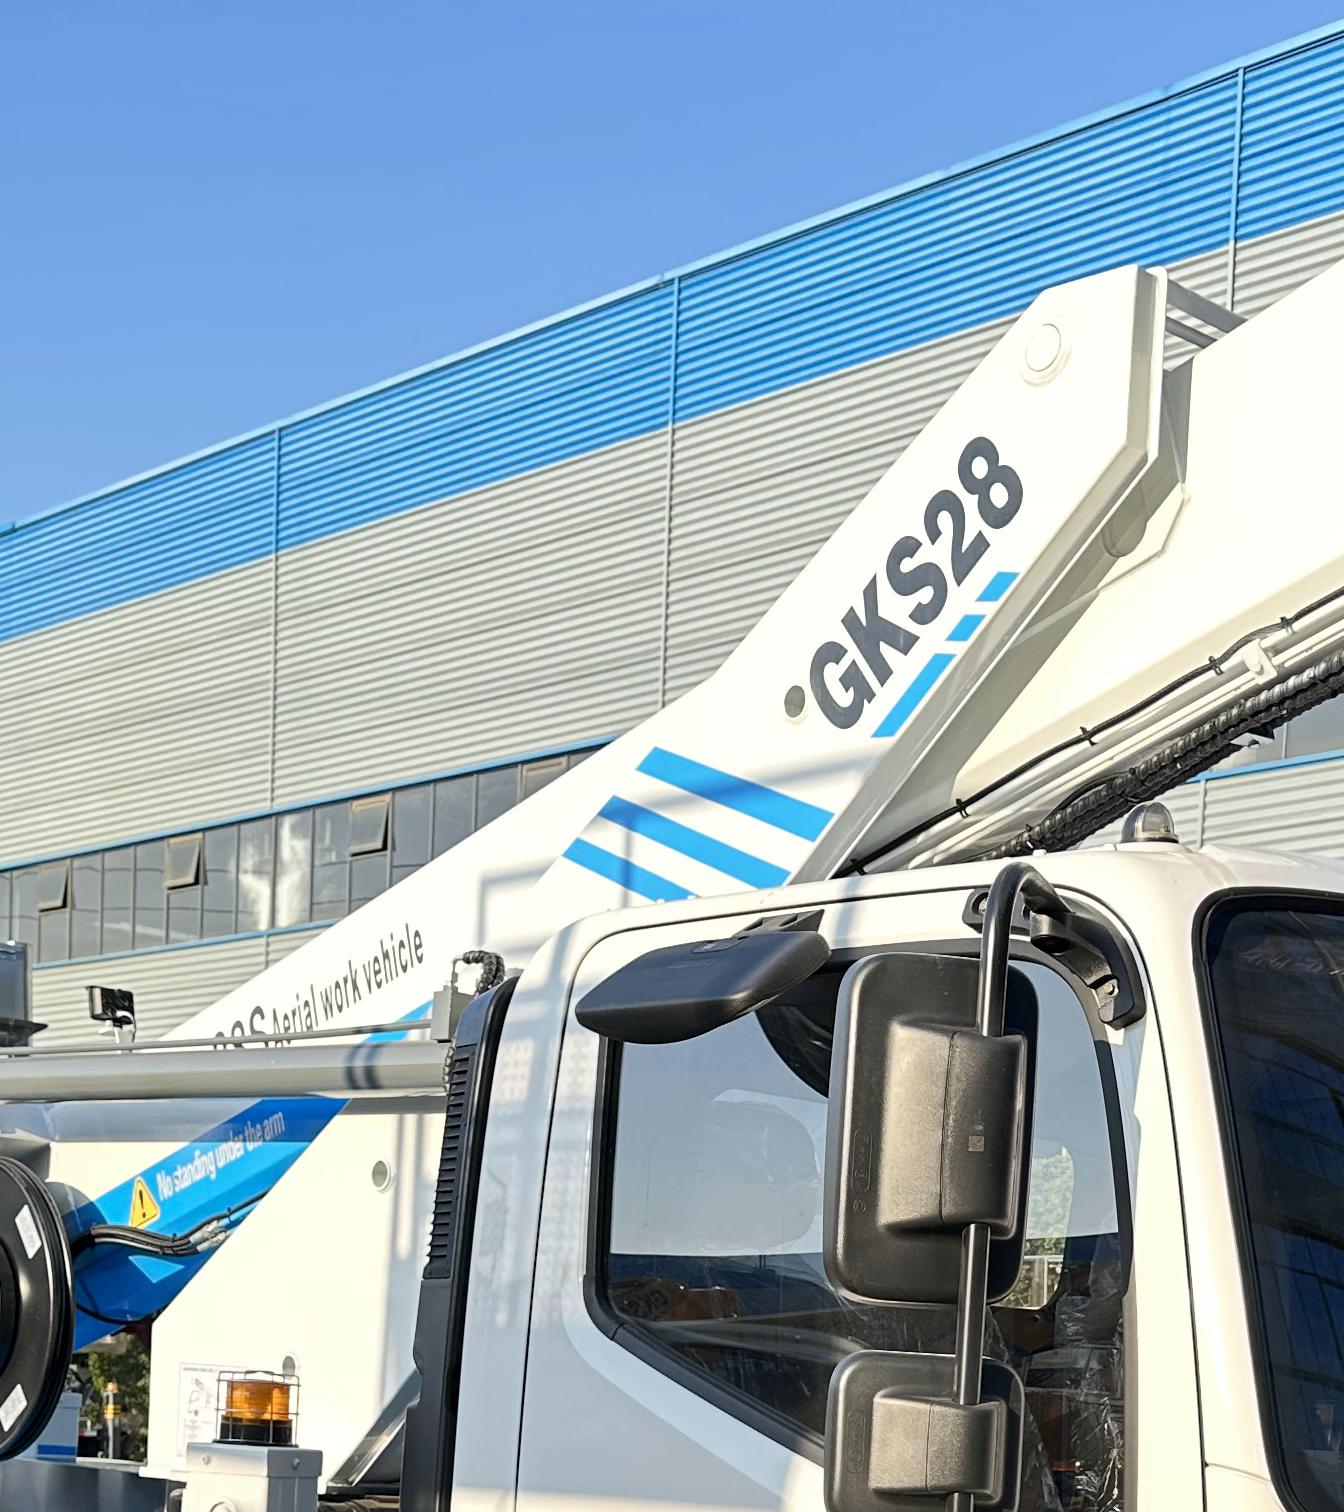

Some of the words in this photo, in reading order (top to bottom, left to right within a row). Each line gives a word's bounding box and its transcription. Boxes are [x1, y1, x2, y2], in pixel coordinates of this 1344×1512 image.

[809, 436, 1023, 729] GKS28
[320, 959, 362, 1021] work
[363, 922, 424, 994] vehicle
[156, 1169, 173, 1201] No
[172, 1150, 217, 1193] standing
[214, 1128, 245, 1169] under
[244, 1120, 263, 1152] the
[263, 1111, 286, 1141] arm
